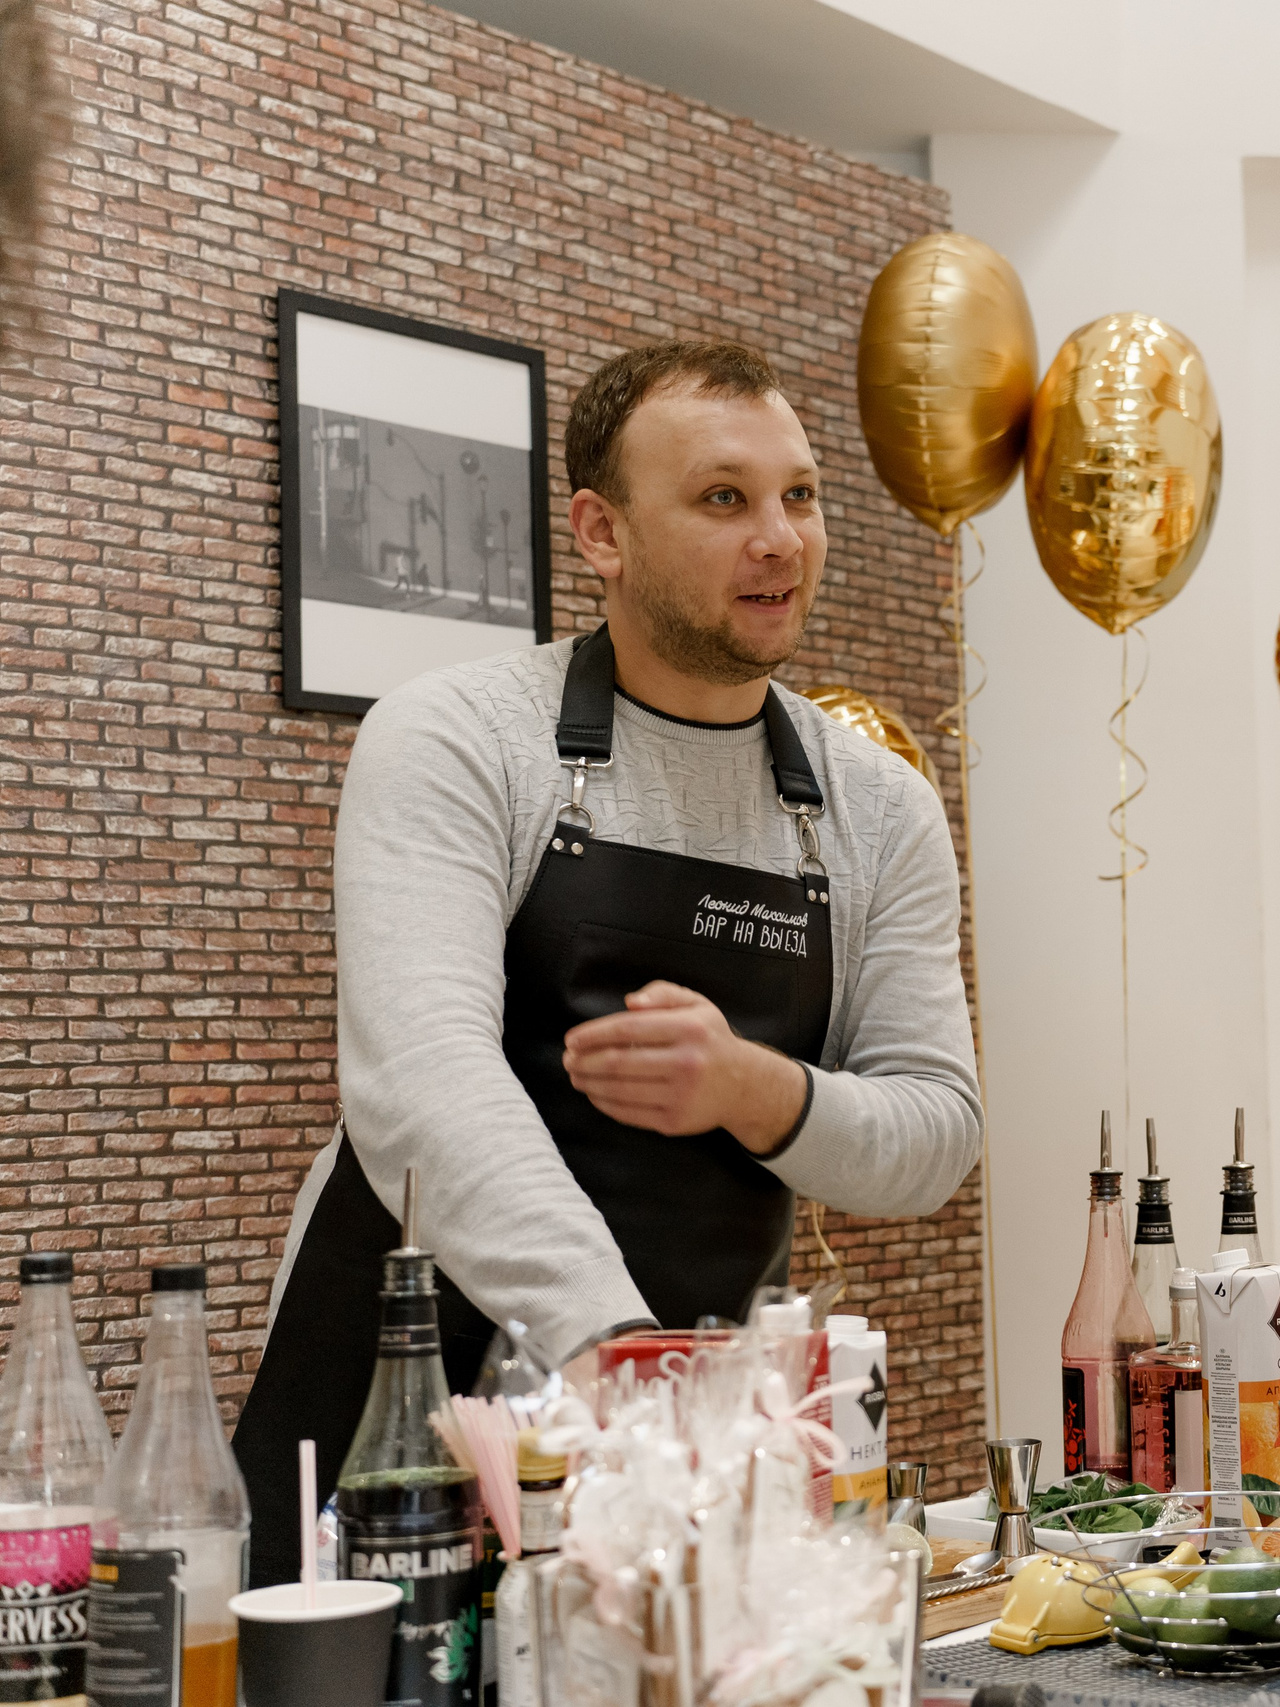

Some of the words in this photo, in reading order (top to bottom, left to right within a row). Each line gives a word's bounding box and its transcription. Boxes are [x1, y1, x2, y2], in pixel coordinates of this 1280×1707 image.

[698, 894, 750, 915] Леонид
[750, 903, 808, 927] Максимов
[692, 912, 728, 939] БАР
[733, 920, 754, 944] НА
[759, 925, 807, 958] ВЫЕЗД
[1142, 1226, 1169, 1234] BARLINE
[1228, 1216, 1254, 1224] BARLINE
[350, 1543, 473, 1579] BARLINE
[0, 1598, 87, 1644] ERVESS
